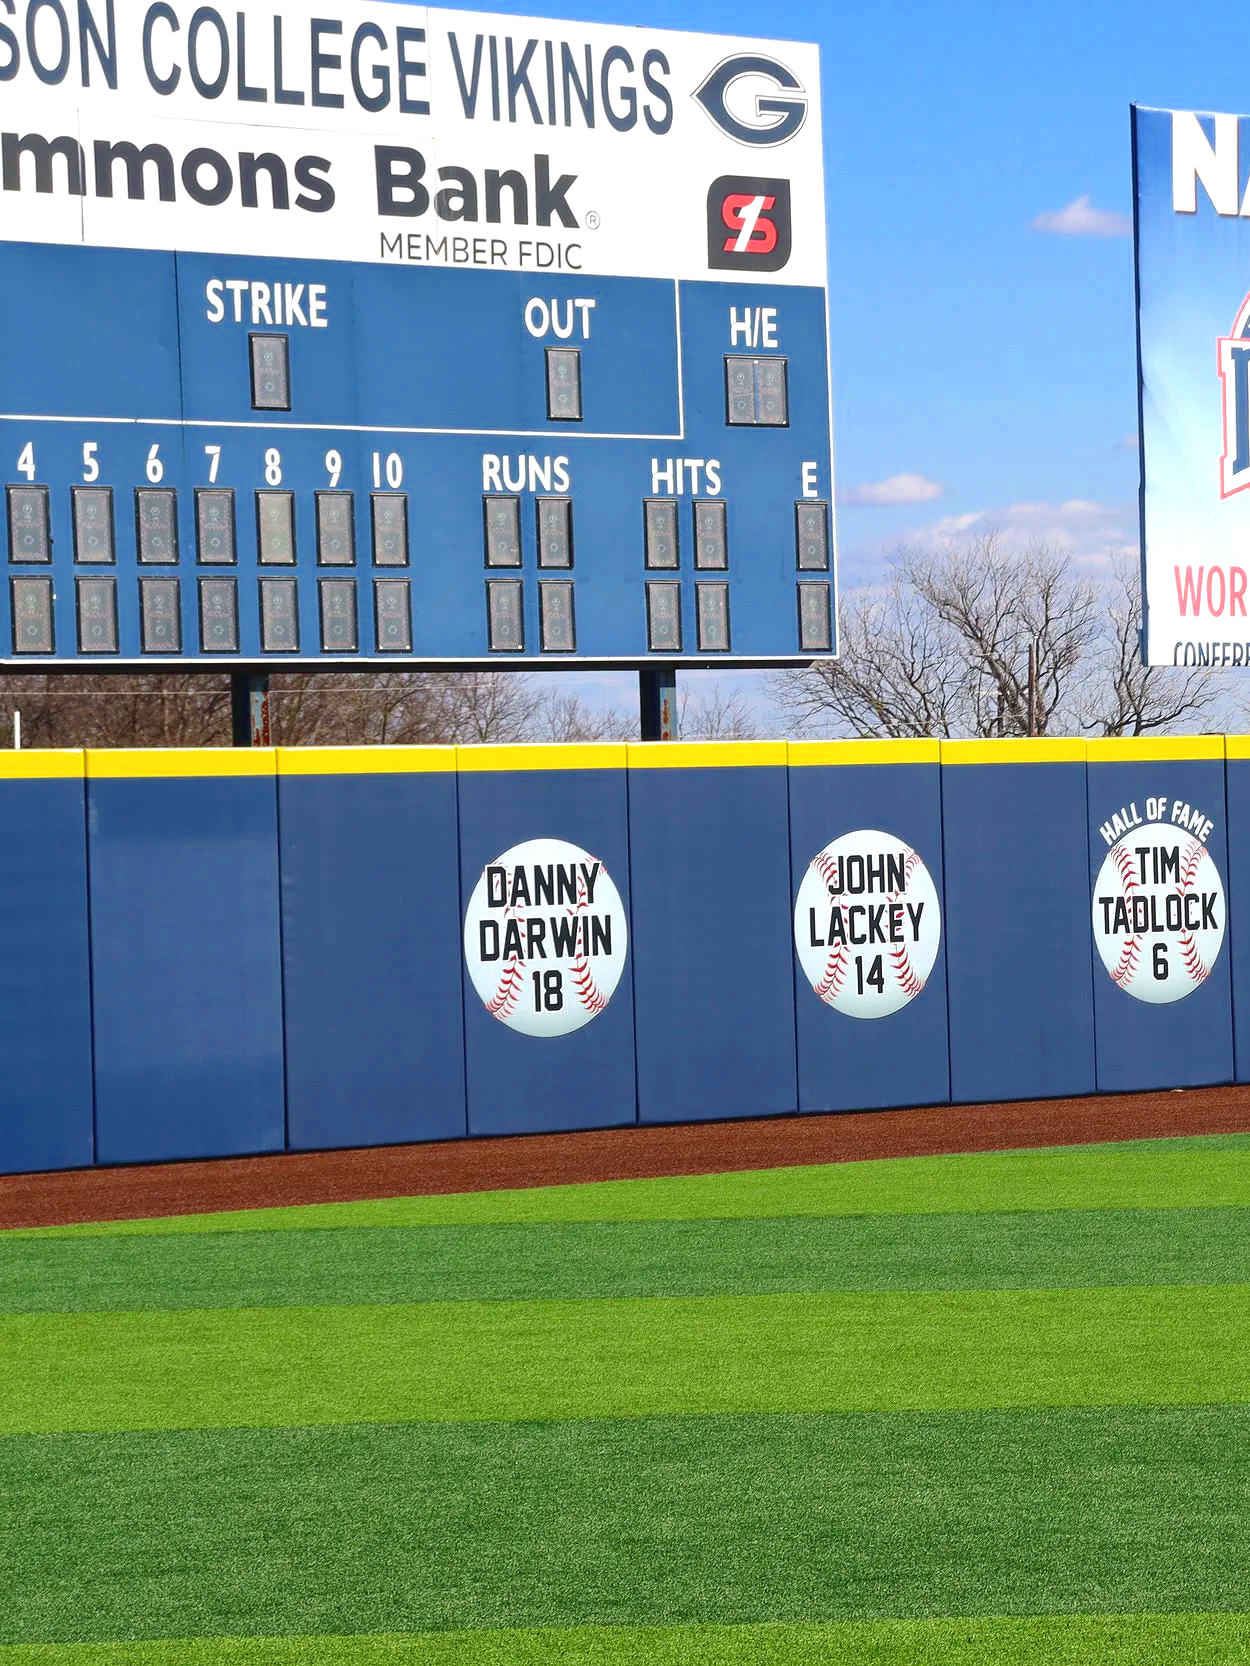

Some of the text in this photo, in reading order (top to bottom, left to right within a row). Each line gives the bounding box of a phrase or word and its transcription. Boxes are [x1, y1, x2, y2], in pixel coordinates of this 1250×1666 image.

[143, 0, 431, 115] COLLEGE
[447, 31, 673, 136] VIKINGS
[1, 132, 333, 213] mmons
[379, 233, 583, 270] MEMBER FDIC
[205, 279, 329, 328] STRIKE
[524, 298, 597, 339] OUT
[729, 306, 779, 349] H/E
[16, 442, 403, 489] 4 5 6 7 8 9 10
[482, 453, 571, 493] RUNS
[651, 458, 722, 496] HITS
[802, 461, 818, 498] E
[1099, 797, 1215, 846] HALL OF FAME
[486, 862, 602, 908] DANNY
[828, 853, 906, 894] JOHN
[1135, 846, 1180, 885] TIM
[809, 902, 924, 948] LACKEY
[1099, 892, 1218, 935] TADLOCK
[479, 914, 613, 962] DARWIN
[855, 955, 885, 995] 14
[1152, 943, 1168, 980] 6
[532, 969, 563, 1012] 18
